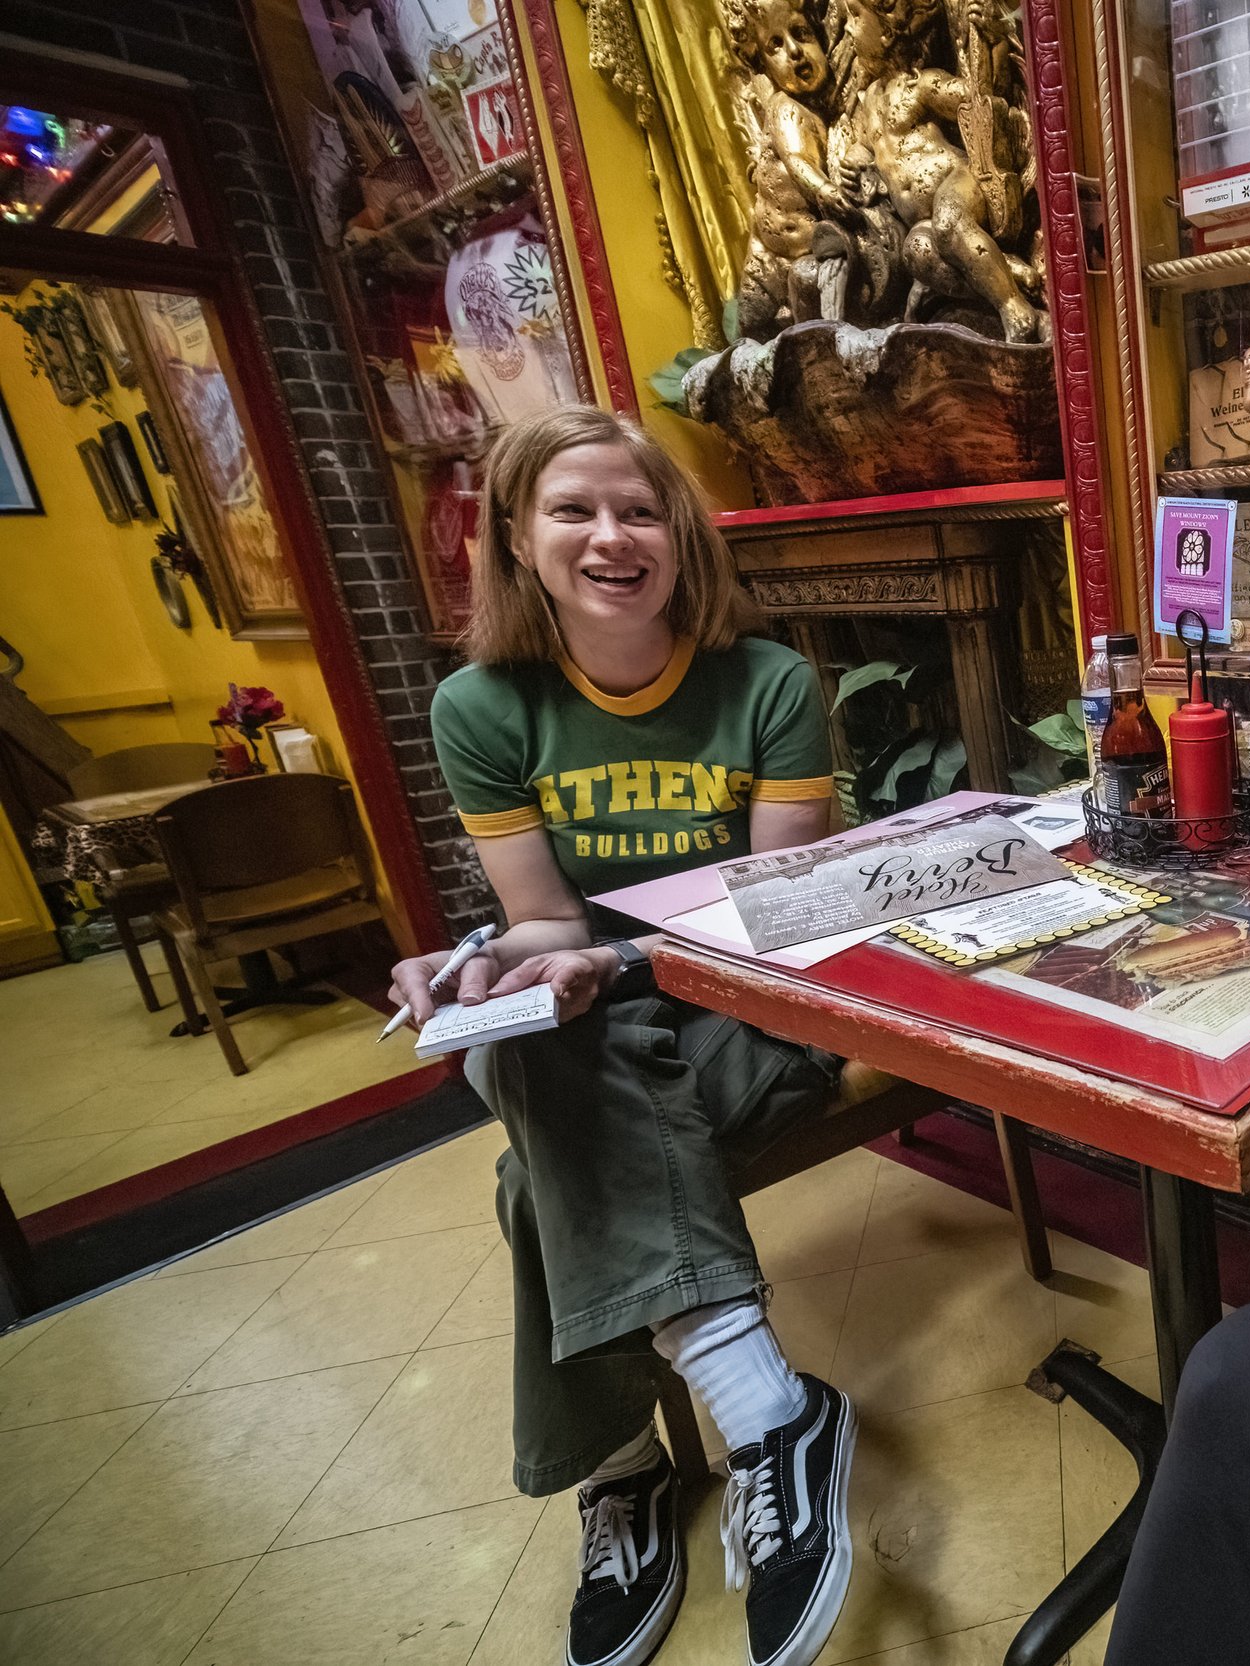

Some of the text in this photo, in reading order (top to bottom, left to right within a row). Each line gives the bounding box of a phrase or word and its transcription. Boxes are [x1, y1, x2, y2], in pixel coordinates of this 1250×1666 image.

[1205, 194, 1229, 204] PRESTO
[1210, 402, 1245, 418] Weine
[575, 823, 731, 858] BULLDOGS
[858, 838, 1027, 893] Berry
[875, 872, 988, 912] Hotel
[807, 915, 863, 931] HOTEL BERRY
